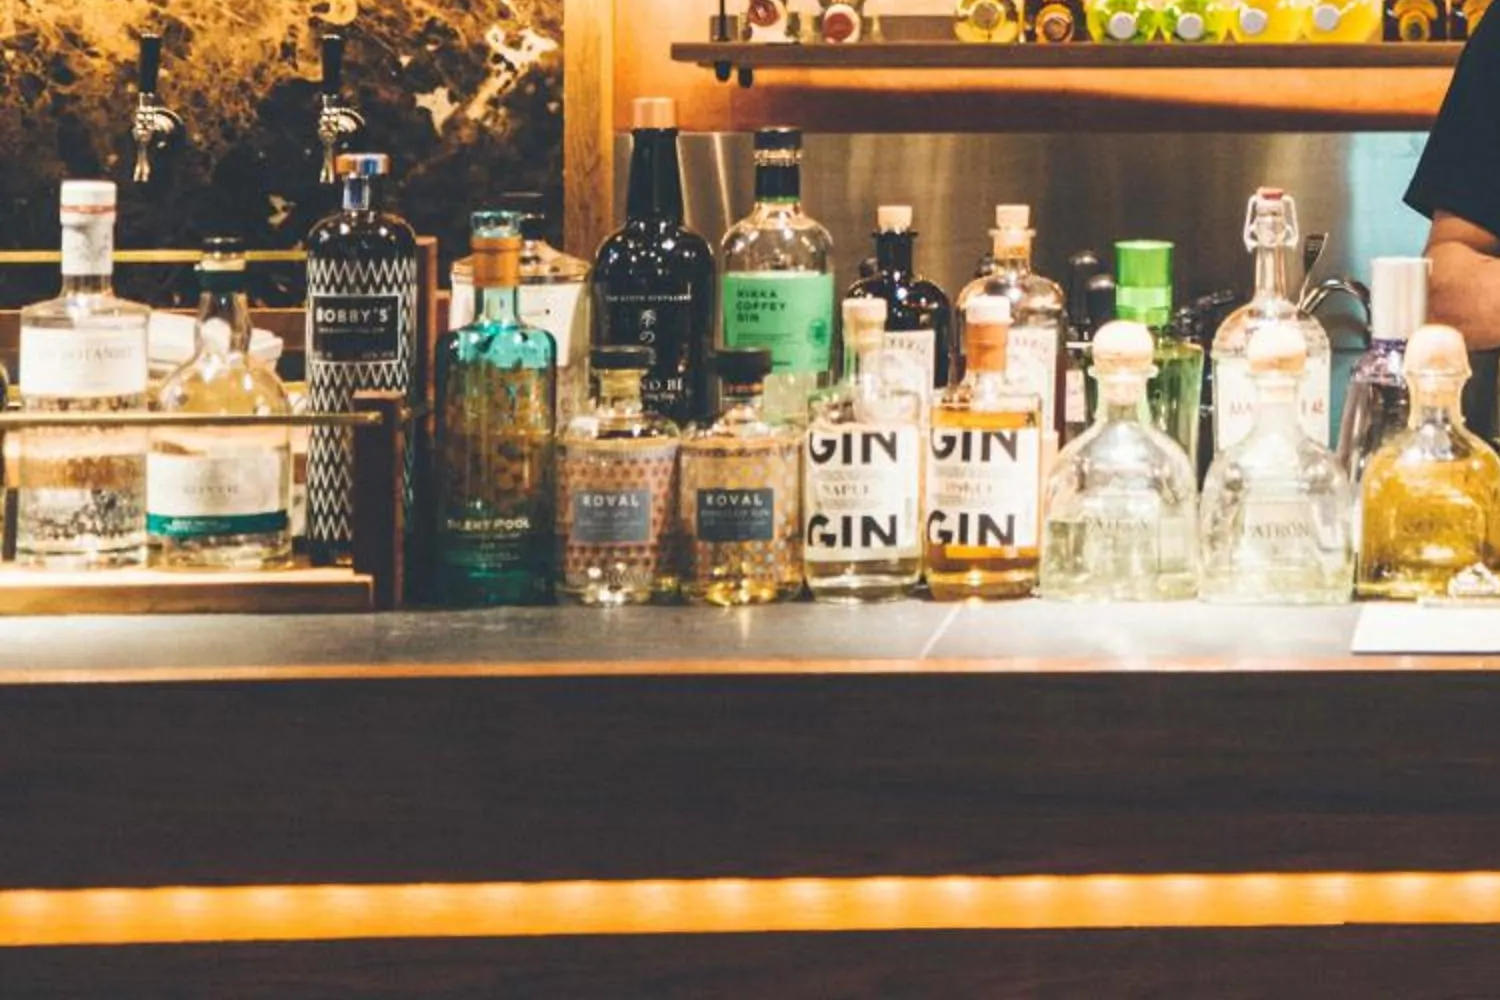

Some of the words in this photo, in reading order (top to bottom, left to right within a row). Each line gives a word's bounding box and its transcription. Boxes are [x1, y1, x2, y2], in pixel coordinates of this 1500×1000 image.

[735, 301, 786, 311] COFFEY
[736, 289, 778, 299] NIKKA
[315, 306, 389, 324] BOBBY'S
[809, 430, 898, 465] GIN
[930, 430, 1018, 463] GIN
[807, 513, 898, 548] GIN
[926, 509, 1015, 547] GIN
